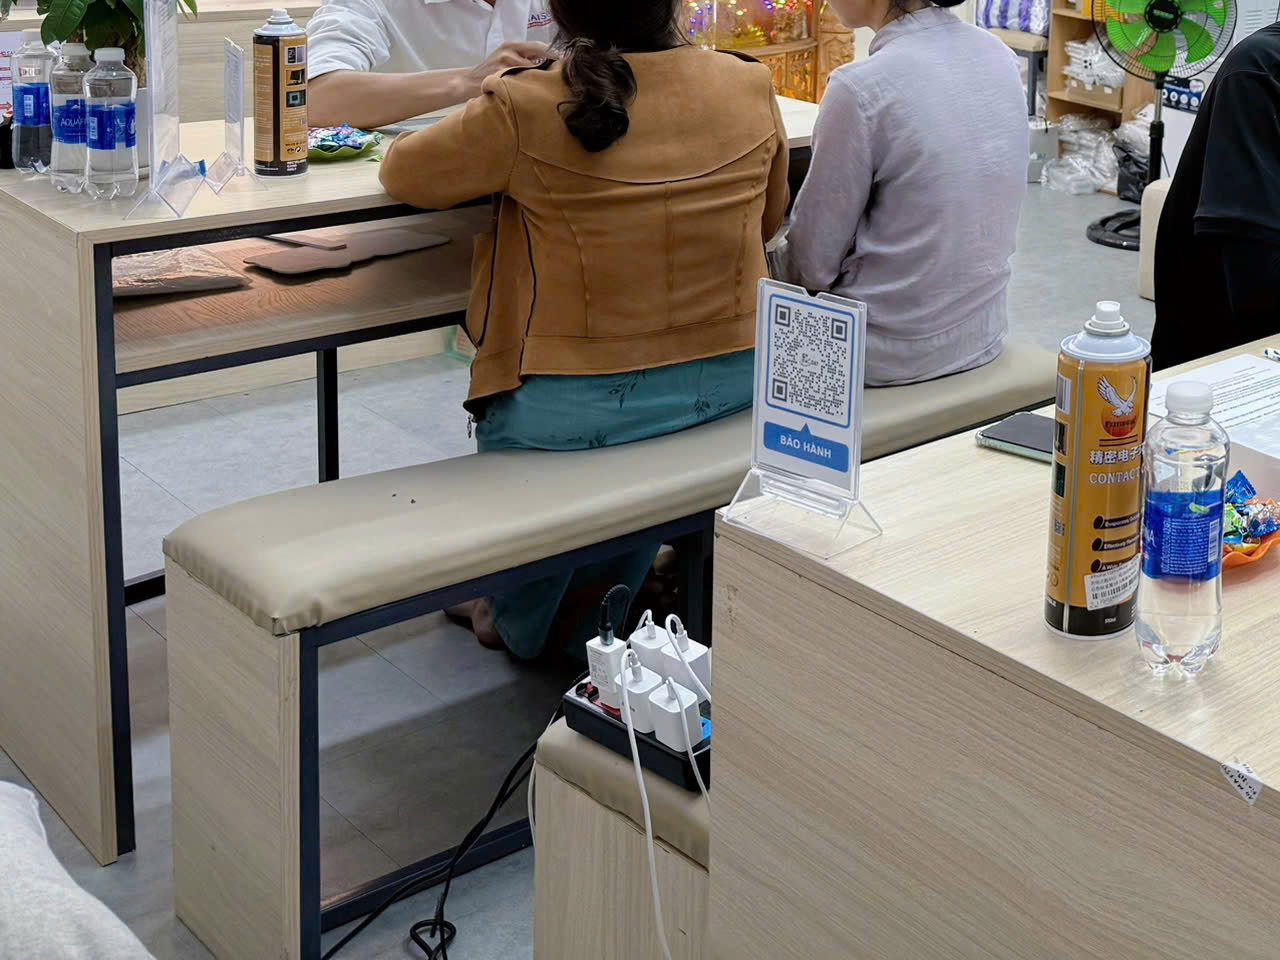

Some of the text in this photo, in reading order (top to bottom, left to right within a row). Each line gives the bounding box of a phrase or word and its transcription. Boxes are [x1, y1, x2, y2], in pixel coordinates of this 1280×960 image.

[780, 432, 832, 459] BẢO HÀNH
[1089, 442, 1145, 465] 精密电子
[1088, 467, 1141, 485] CONTACT
